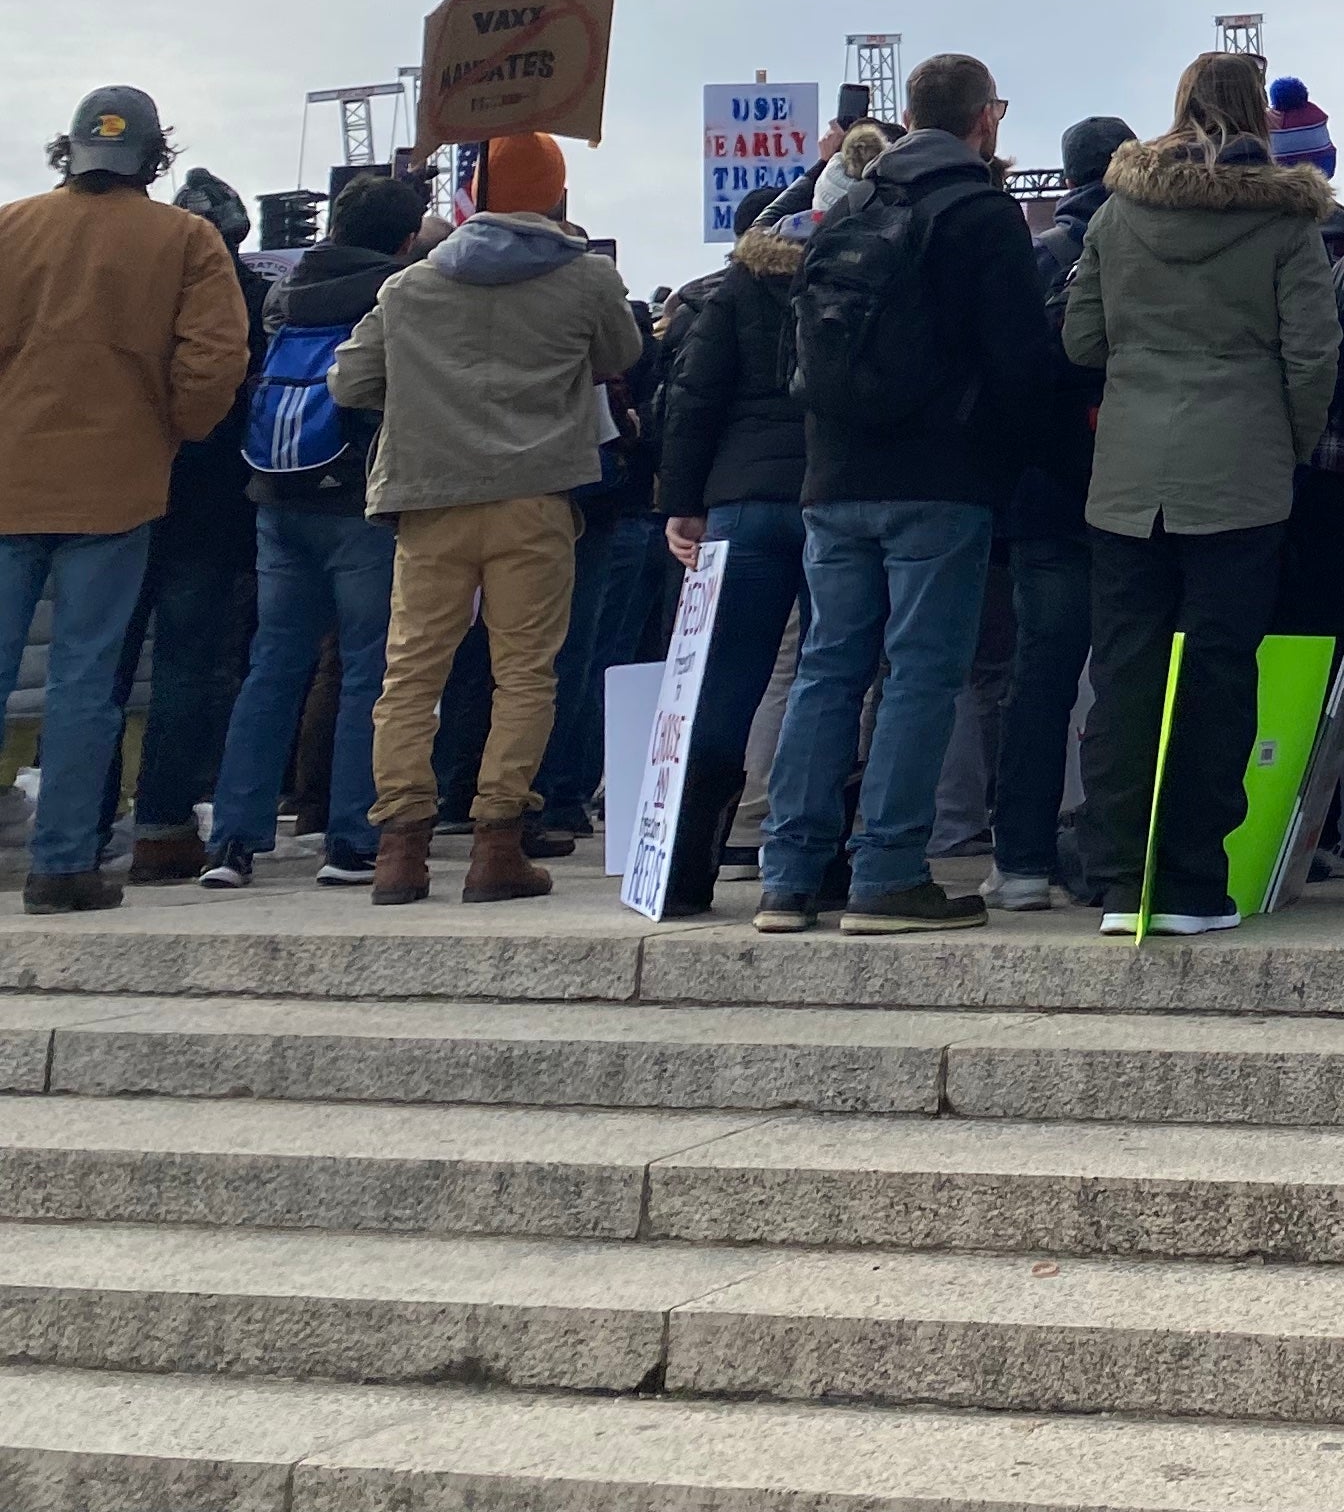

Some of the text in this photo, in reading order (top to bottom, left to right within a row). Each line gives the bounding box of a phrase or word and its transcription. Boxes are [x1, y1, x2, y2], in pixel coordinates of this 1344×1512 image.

[472, 5, 546, 34] VAXX
[732, 97, 787, 121] USE
[713, 131, 807, 158] EARLY
